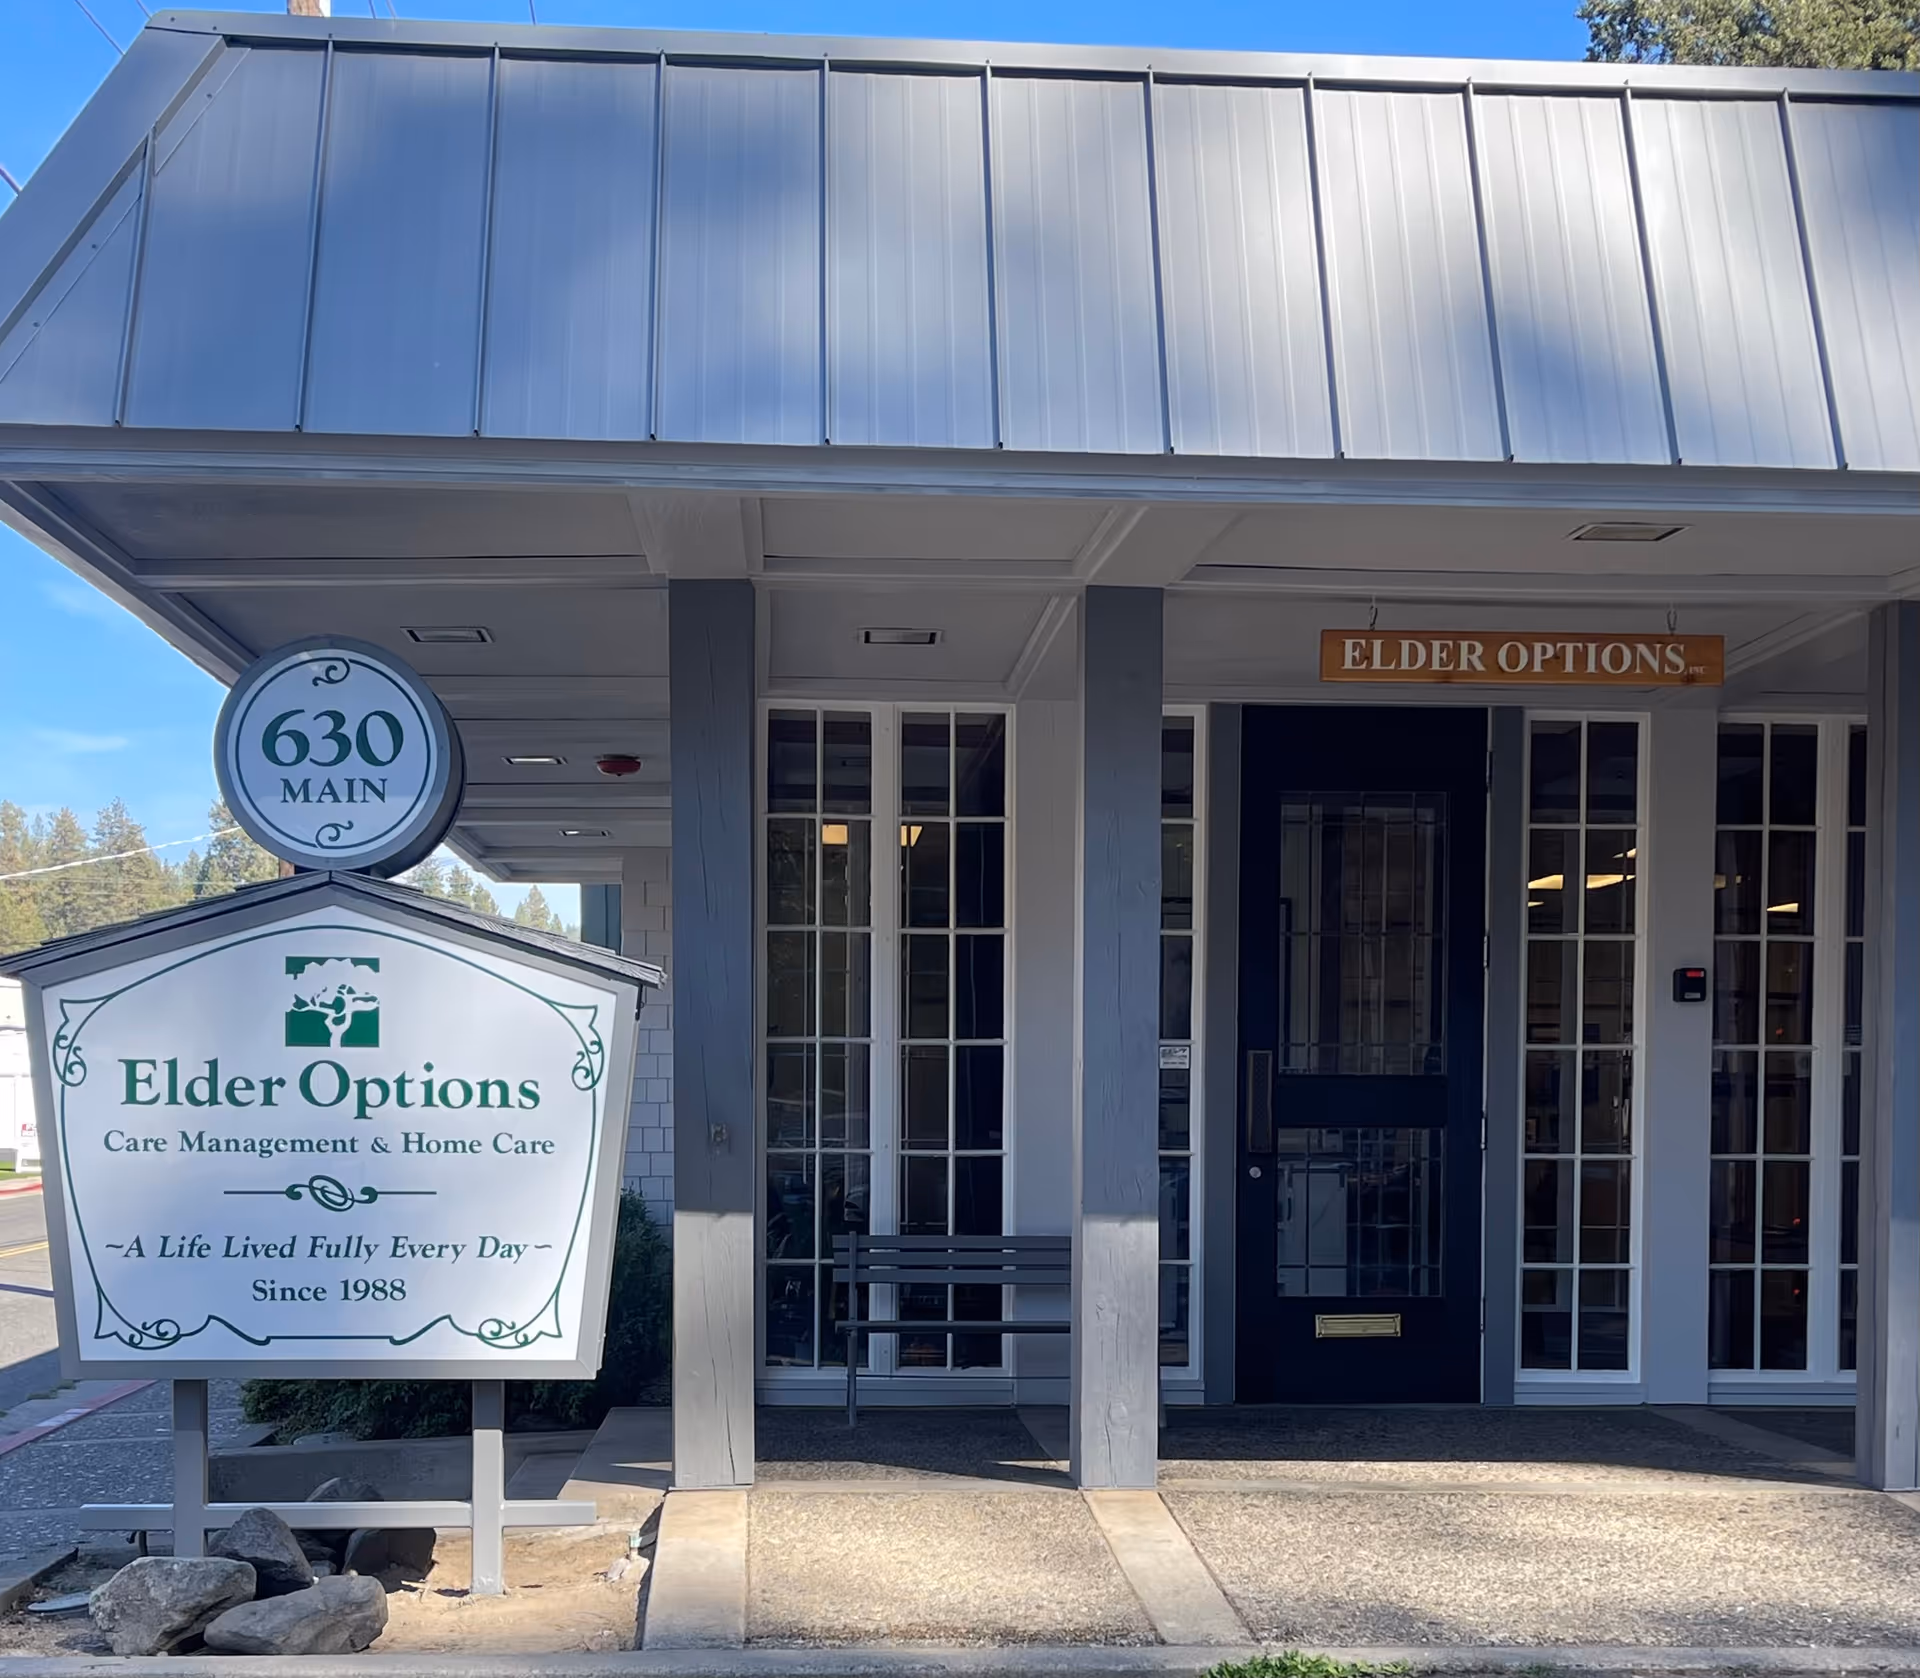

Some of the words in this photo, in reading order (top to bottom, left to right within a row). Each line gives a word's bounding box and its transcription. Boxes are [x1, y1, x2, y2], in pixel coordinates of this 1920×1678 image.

[1341, 638, 1486, 672] ELDER
[261, 708, 404, 767] 630
[280, 777, 388, 804] MAIN
[118, 1057, 286, 1108] Elder
[299, 1059, 541, 1120] Options
[103, 1130, 167, 1153] Care
[178, 1130, 360, 1158] Management
[371, 1136, 391, 1154] &
[401, 1131, 483, 1154] Home
[493, 1132, 556, 1155] Care
[157, 1234, 212, 1259] Life
[222, 1234, 298, 1259] Lived
[307, 1234, 380, 1264] Fully
[389, 1235, 467, 1264] Every
[252, 1279, 328, 1302] Since
[340, 1278, 407, 1302] 1988
